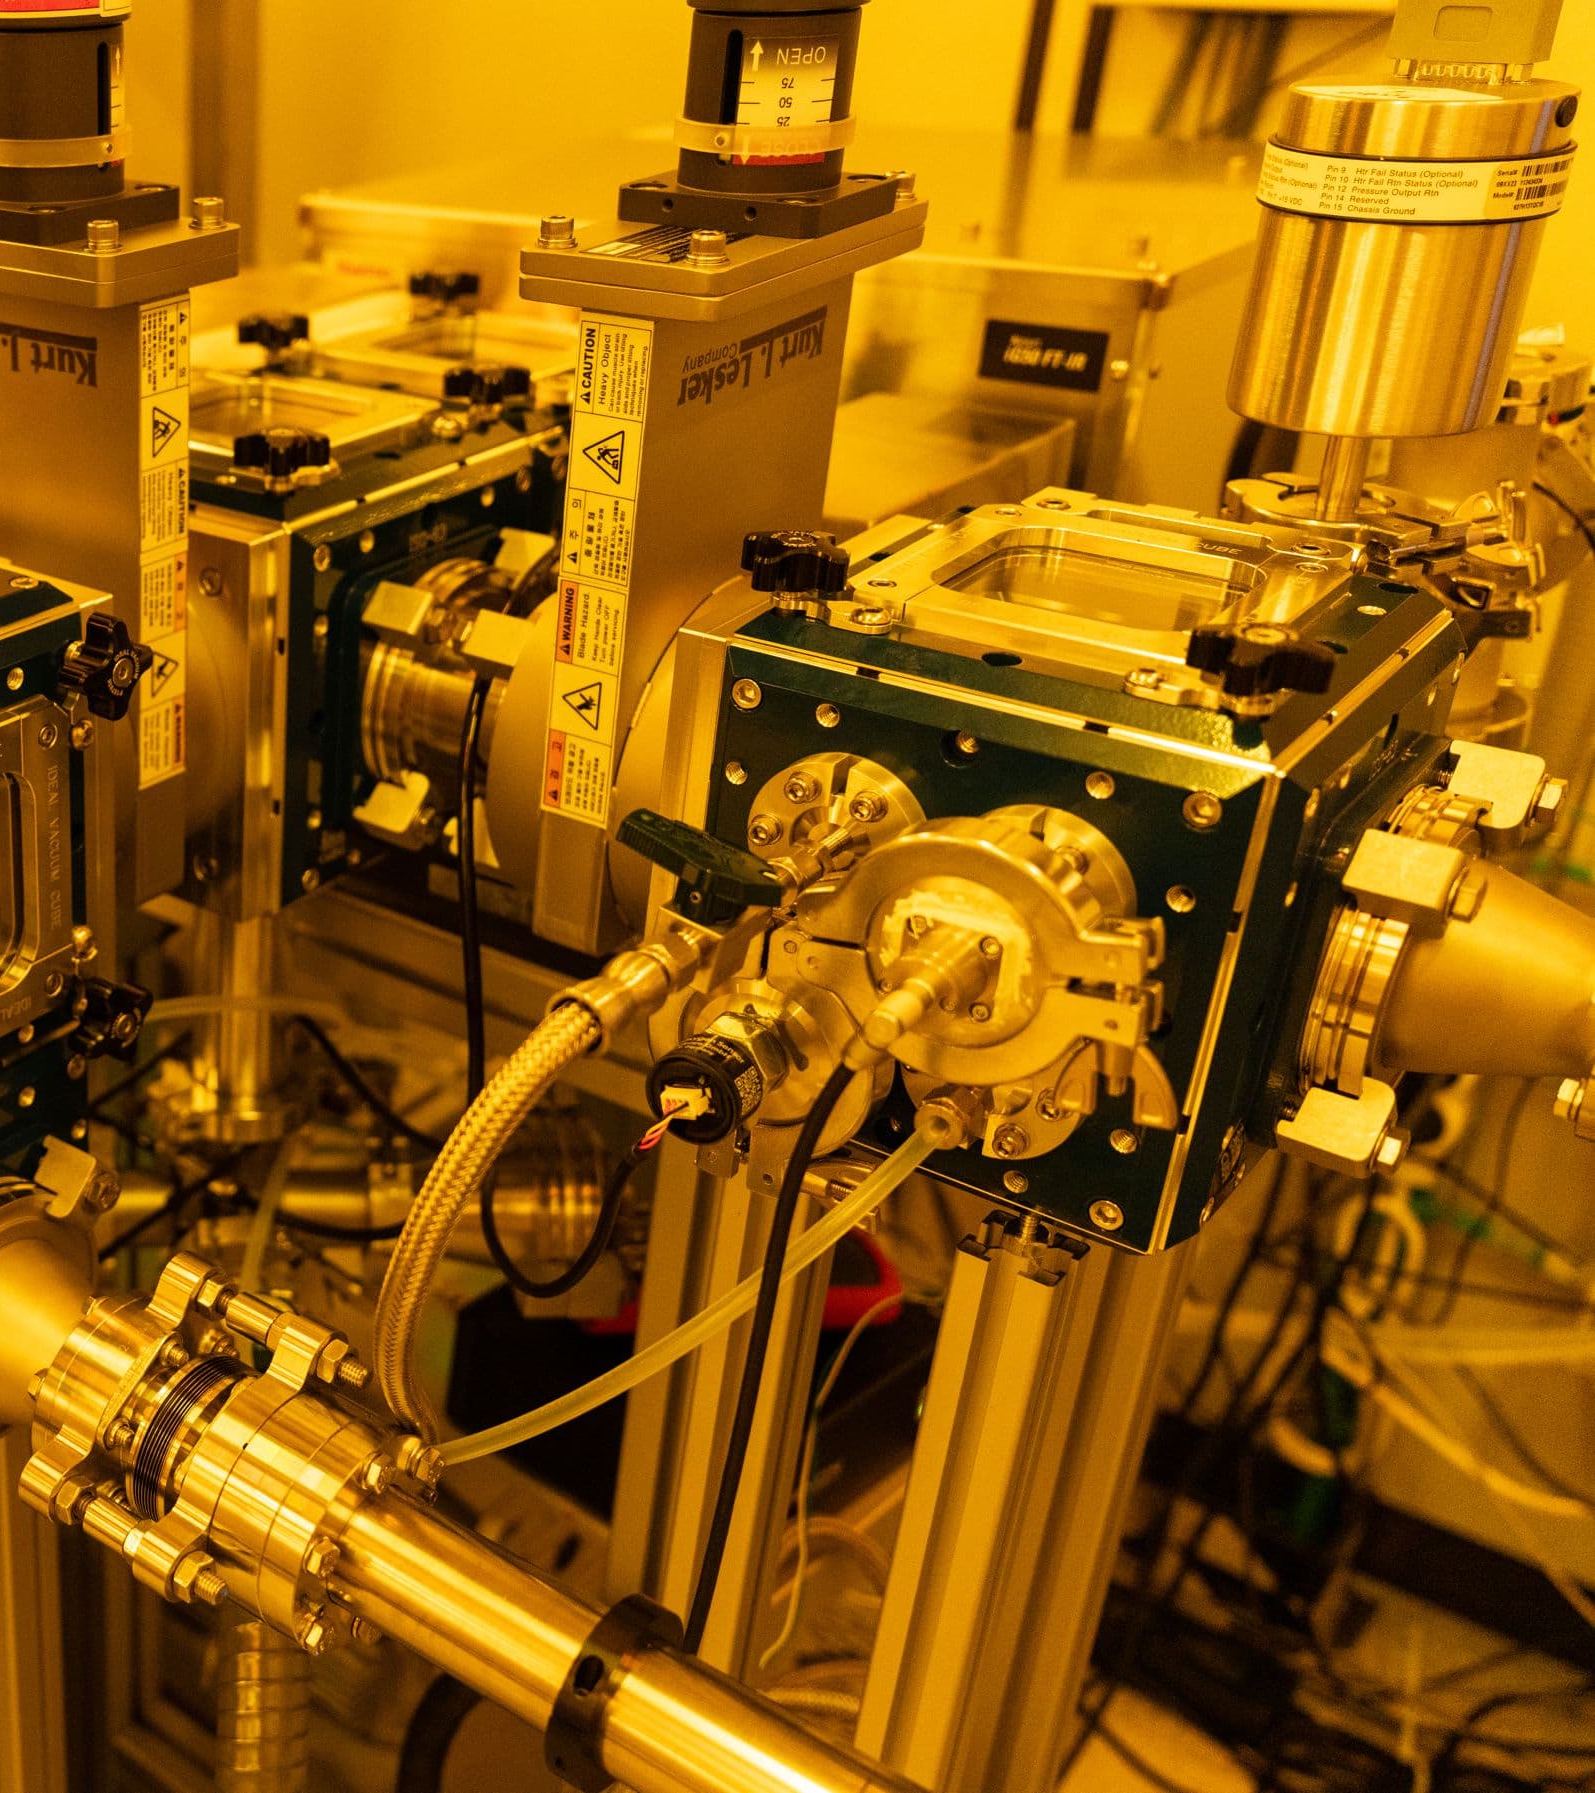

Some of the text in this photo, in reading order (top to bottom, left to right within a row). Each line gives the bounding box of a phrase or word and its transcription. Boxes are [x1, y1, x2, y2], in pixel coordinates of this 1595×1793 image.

[776, 46, 827, 65] OPEN
[781, 77, 795, 89] 75
[779, 96, 793, 108] 50
[777, 116, 791, 127] 25
[1325, 174, 1478, 189] Pin 10 Htr Fail Rtn Status (Optional)
[1327, 165, 1338, 173] Pin
[1371, 168, 1386, 176] Fail
[1389, 169, 1418, 178] Status
[1420, 170, 1463, 179] (Optional)
[1321, 193, 1333, 201] Pin
[1349, 195, 1389, 205] Reserved
[1323, 183, 1335, 191] Pin
[1351, 186, 1389, 195] Pressure
[1391, 188, 1421, 198] Output
[1424, 189, 1439, 197] Rtn
[1333, 203, 1343, 211] 15
[1347, 204, 1380, 214] Chassis
[1382, 206, 1415, 216] Ground
[1, 336, 20, 373] J.
[30, 343, 98, 387] Kurt
[582, 328, 596, 388] CAUTION
[677, 319, 825, 407] Kurt J. Lesker
[682, 343, 738, 373] Company
[598, 334, 612, 405] Heavy Object
[561, 588, 575, 640] WARNING
[577, 592, 590, 658] Blade Hazard.
[47, 764, 60, 808] IDEAL
